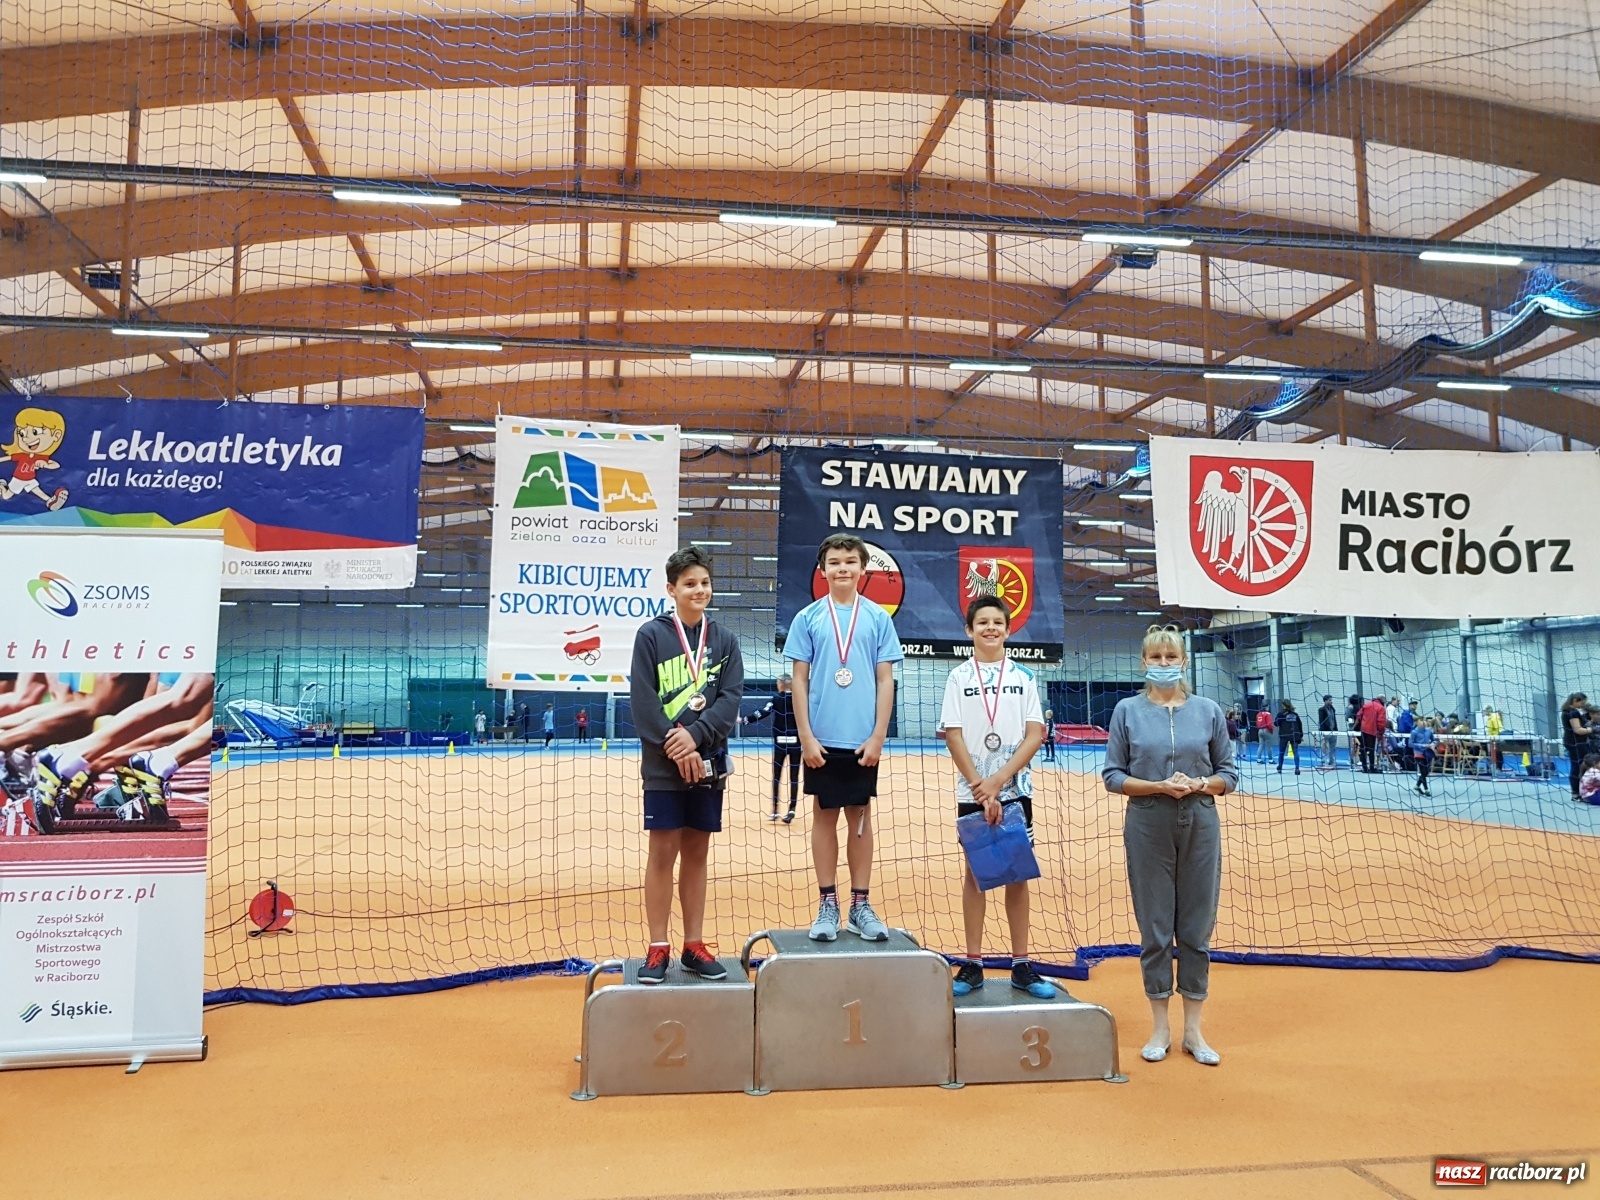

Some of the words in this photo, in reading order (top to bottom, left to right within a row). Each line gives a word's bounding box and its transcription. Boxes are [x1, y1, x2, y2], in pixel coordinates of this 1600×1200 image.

[88, 429, 343, 471] Lekkoatletyka
[86, 468, 119, 487] dla
[125, 468, 223, 493] każdego!
[821, 460, 1028, 495] STAWIAMY
[1341, 488, 1471, 520] MIASTO
[511, 513, 569, 530] powiat
[580, 516, 658, 533] raciborski
[829, 501, 884, 530] NA
[893, 505, 1019, 536] SPORT
[510, 532, 561, 542] zielona
[572, 535, 606, 544] oaza
[617, 535, 658, 546] kultur
[1338, 523, 1574, 576] Racibórz
[281, 560, 313, 569] ZWIĄZKU
[281, 568, 312, 576] ATLETYKI
[868, 555, 896, 584] CIBÓRZ
[346, 572, 393, 580] NARODOWEJ
[518, 563, 652, 591] KIBICUJEMY
[83, 585, 150, 600] ZSOMS
[83, 601, 149, 609] RACIBÓRZ
[500, 592, 666, 618] SPORTOWCOM
[7, 639, 196, 660] thletics
[37, 914, 73, 926] Zespół
[75, 913, 104, 923] Szkół
[16, 927, 123, 942] Ogólnokształcących
[36, 943, 101, 953] Mistrzostwa
[35, 958, 101, 970] Sportowego
[47, 973, 100, 982] Raciborzu
[51, 1000, 112, 1019] Śląskie.
[842, 999, 868, 1045] 1
[652, 1019, 687, 1067] 2
[1019, 1025, 1052, 1071] 3
